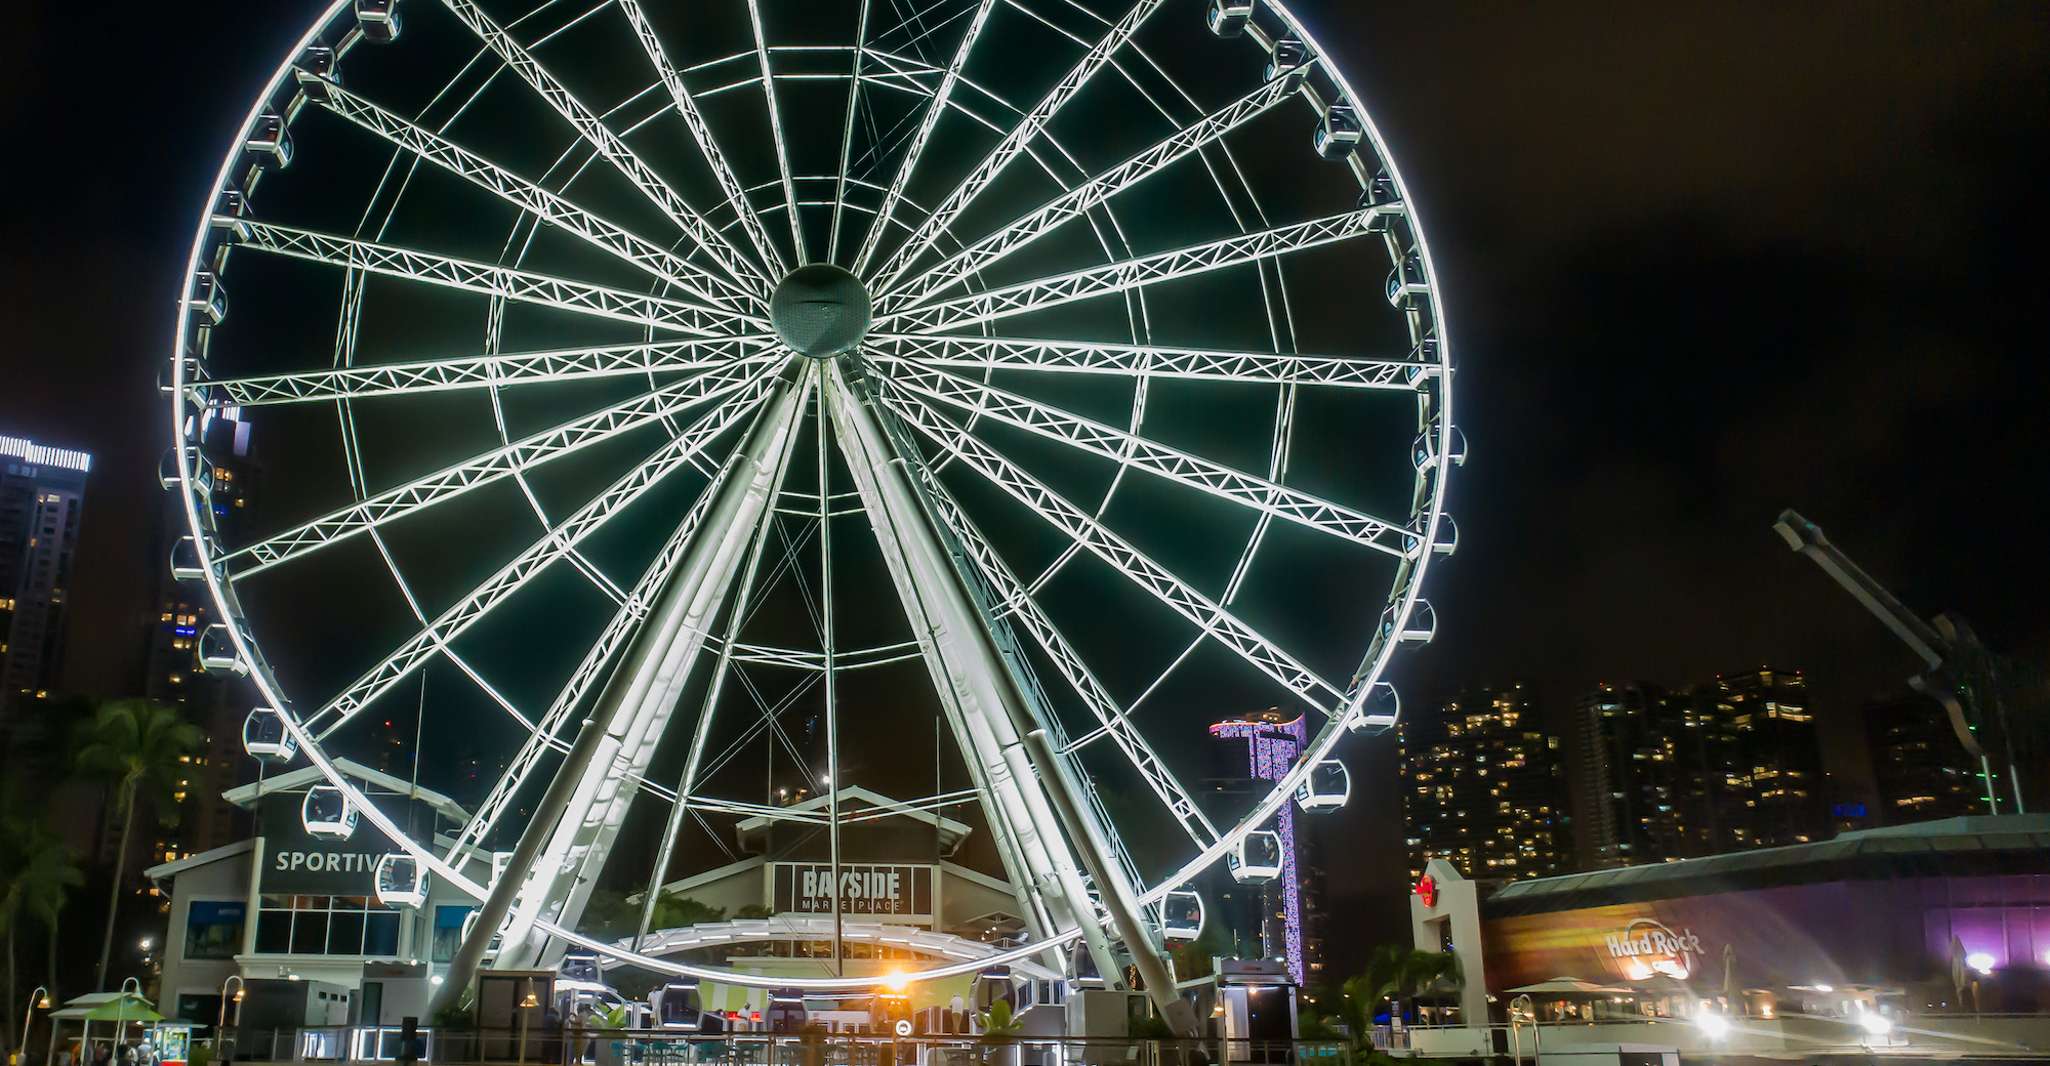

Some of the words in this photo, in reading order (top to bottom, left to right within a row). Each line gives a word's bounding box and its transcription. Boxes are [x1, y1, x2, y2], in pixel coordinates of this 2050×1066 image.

[276, 851, 382, 872] SPORTIV
[803, 871, 900, 899] BAYSIDE
[802, 900, 900, 911] MARETPLACE
[1606, 932, 1653, 957] Hard
[1652, 928, 1705, 958] Rock
